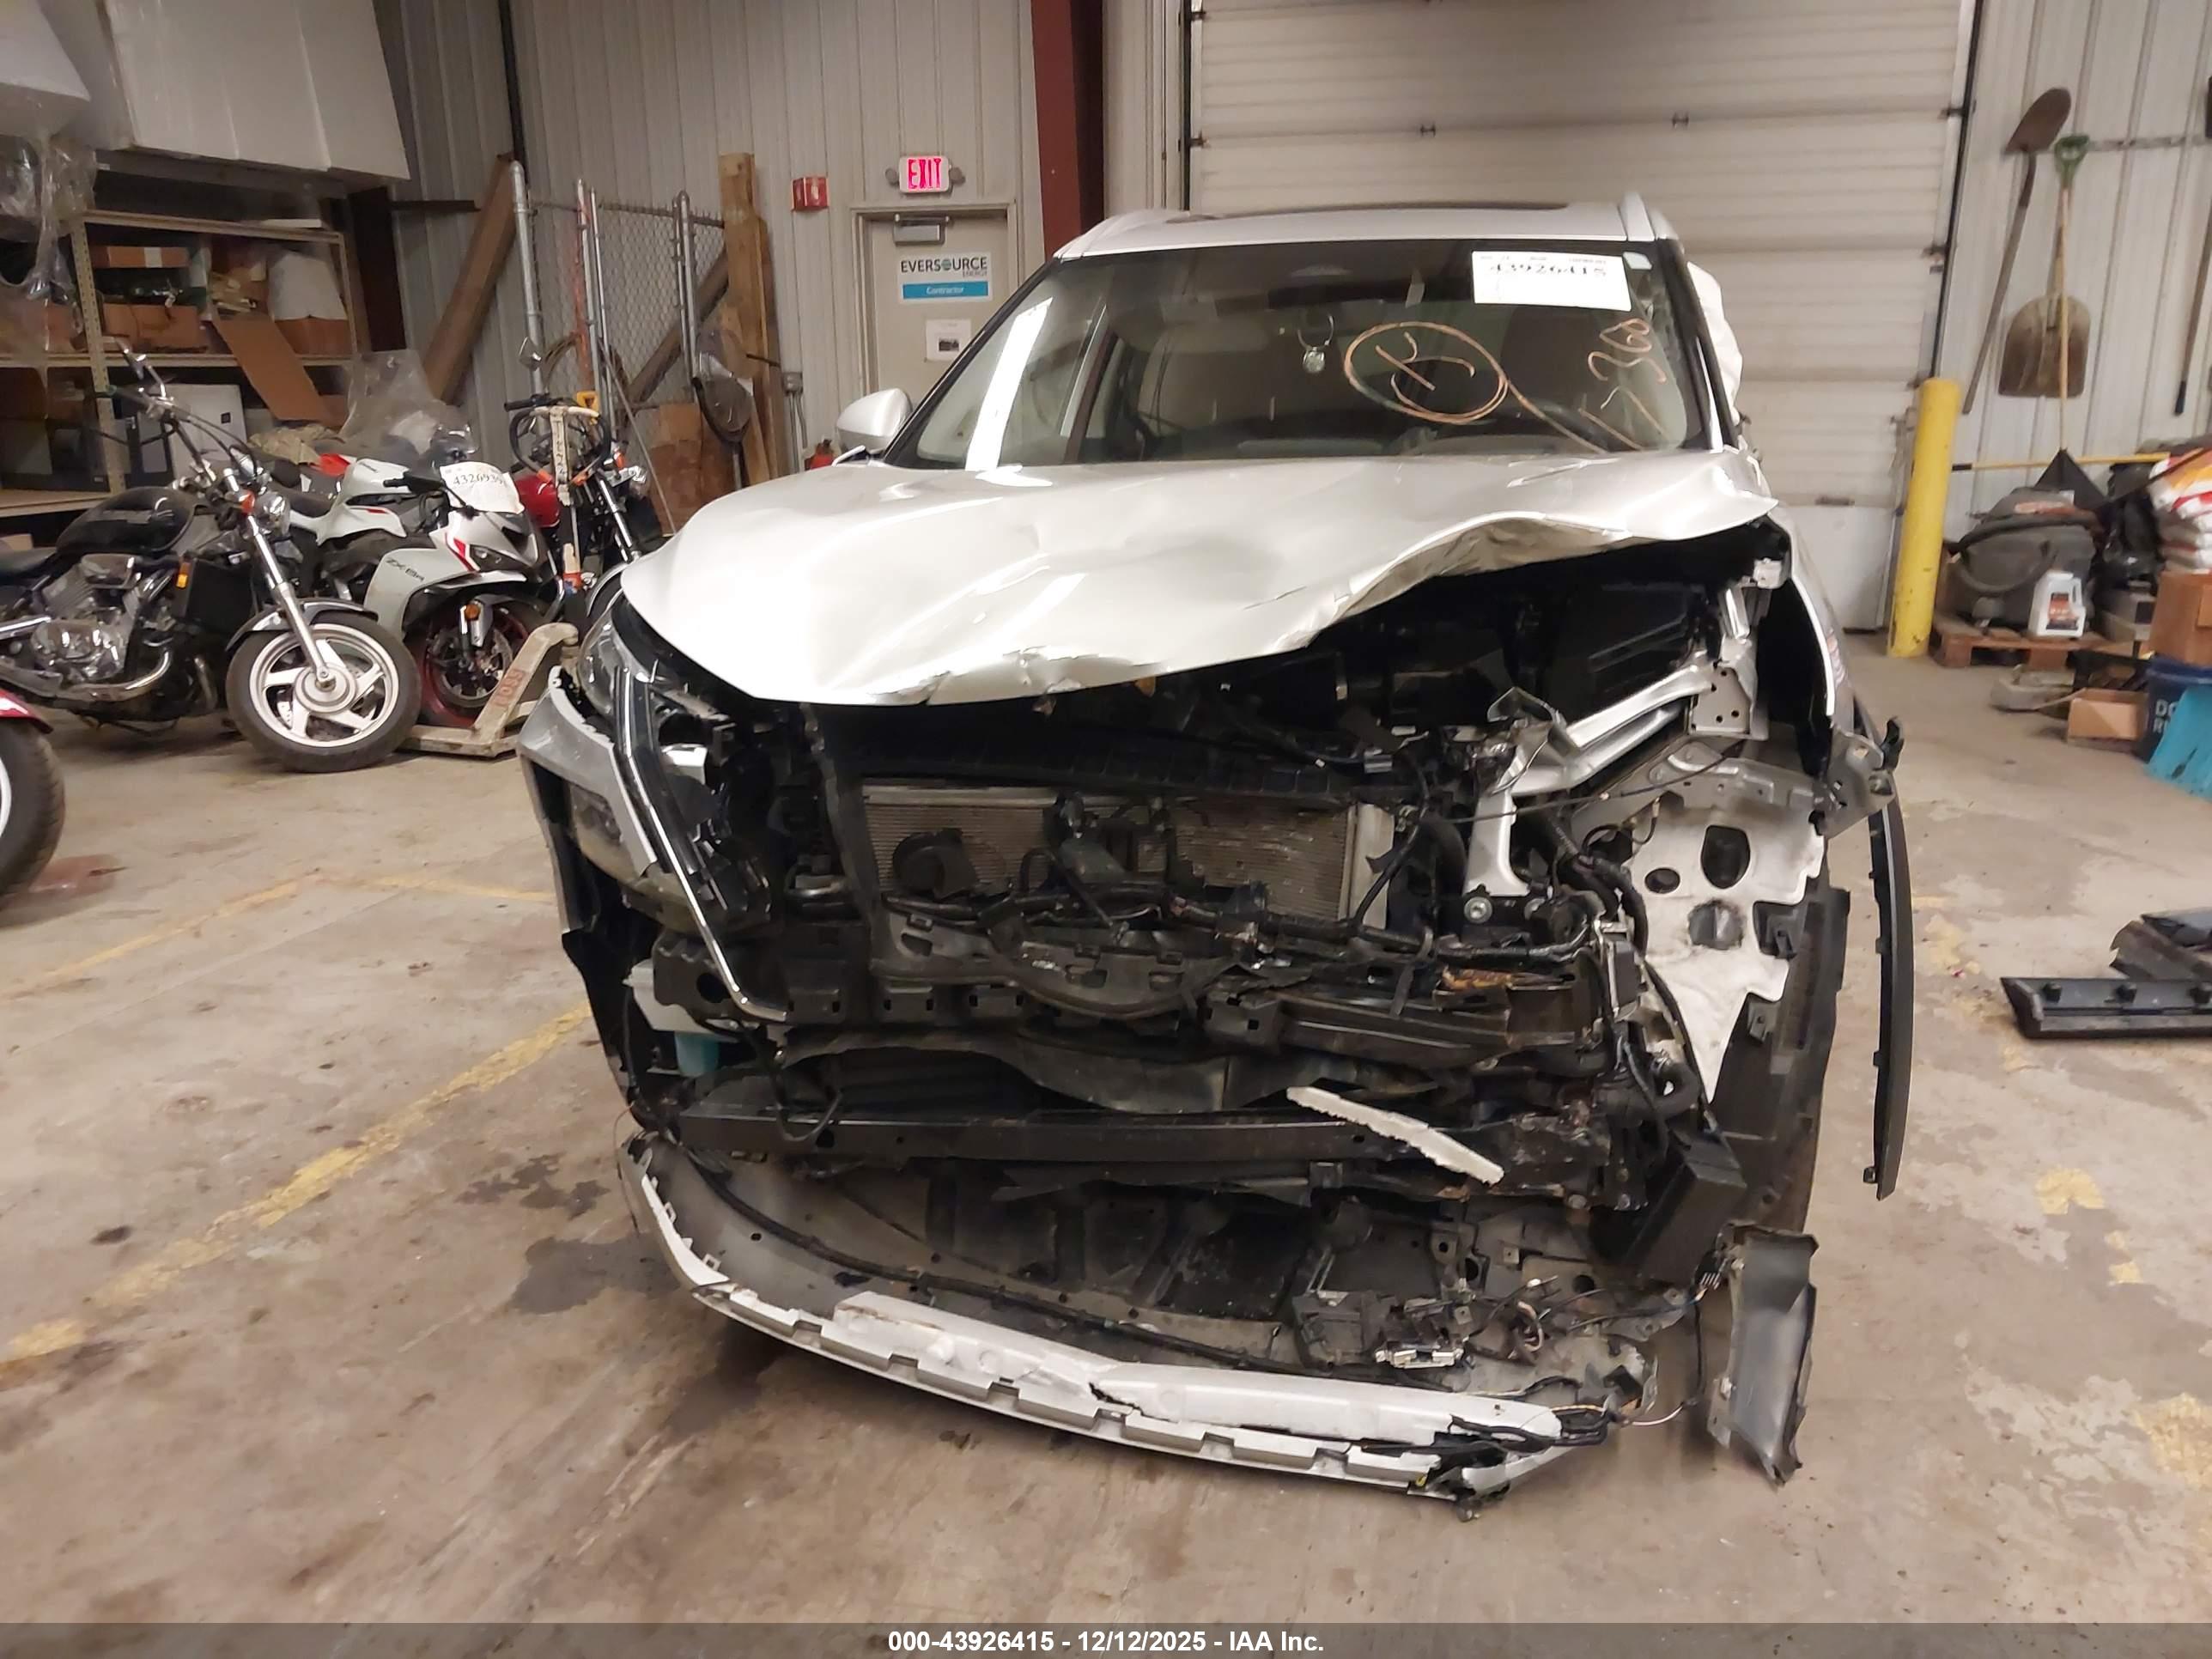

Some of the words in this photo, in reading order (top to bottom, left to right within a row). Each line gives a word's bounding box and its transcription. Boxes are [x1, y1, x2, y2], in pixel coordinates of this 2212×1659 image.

[908, 158, 942, 189] EXIT
[901, 257, 988, 273] EVERSOURCE
[927, 286, 964, 295] Contractor
